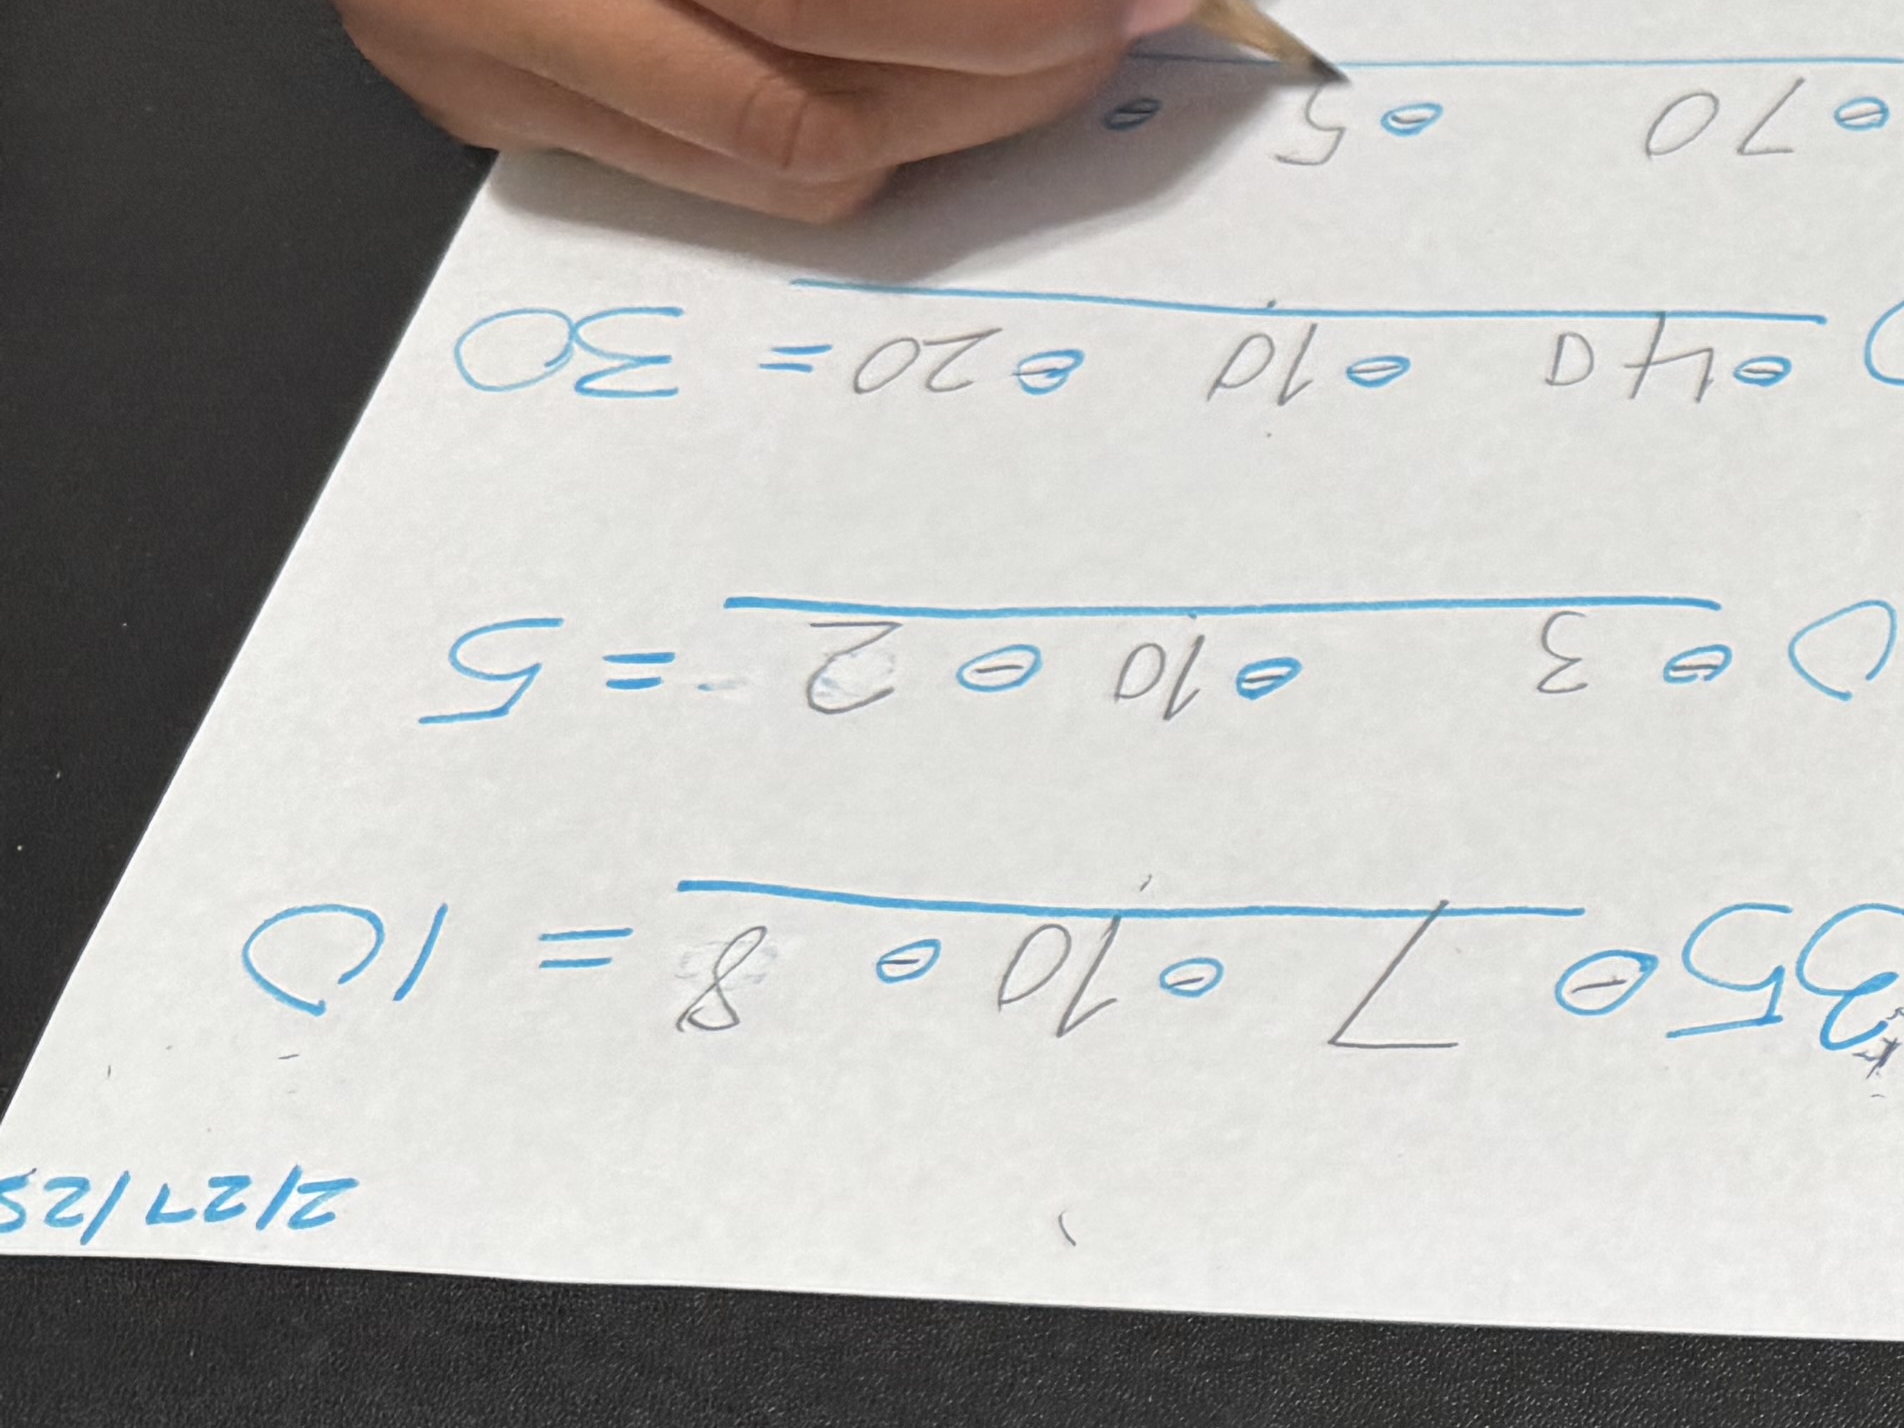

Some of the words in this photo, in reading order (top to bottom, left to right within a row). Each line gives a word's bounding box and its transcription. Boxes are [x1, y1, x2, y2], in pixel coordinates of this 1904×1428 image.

[1274, 82, 1350, 165] 5
[1634, 68, 1805, 159] 70
[454, 306, 684, 398] 30
[851, 329, 1003, 397] 20
[1206, 325, 1318, 406] 10
[1540, 320, 1728, 403] 40
[418, 618, 564, 725] 5
[804, 618, 905, 715] 2
[1113, 620, 1205, 721] 10
[1531, 608, 1593, 694] 3
[242, 903, 448, 1017] 10
[675, 927, 768, 1032] 8
[1000, 918, 1127, 1038] 10
[1330, 901, 1470, 1049] 7
